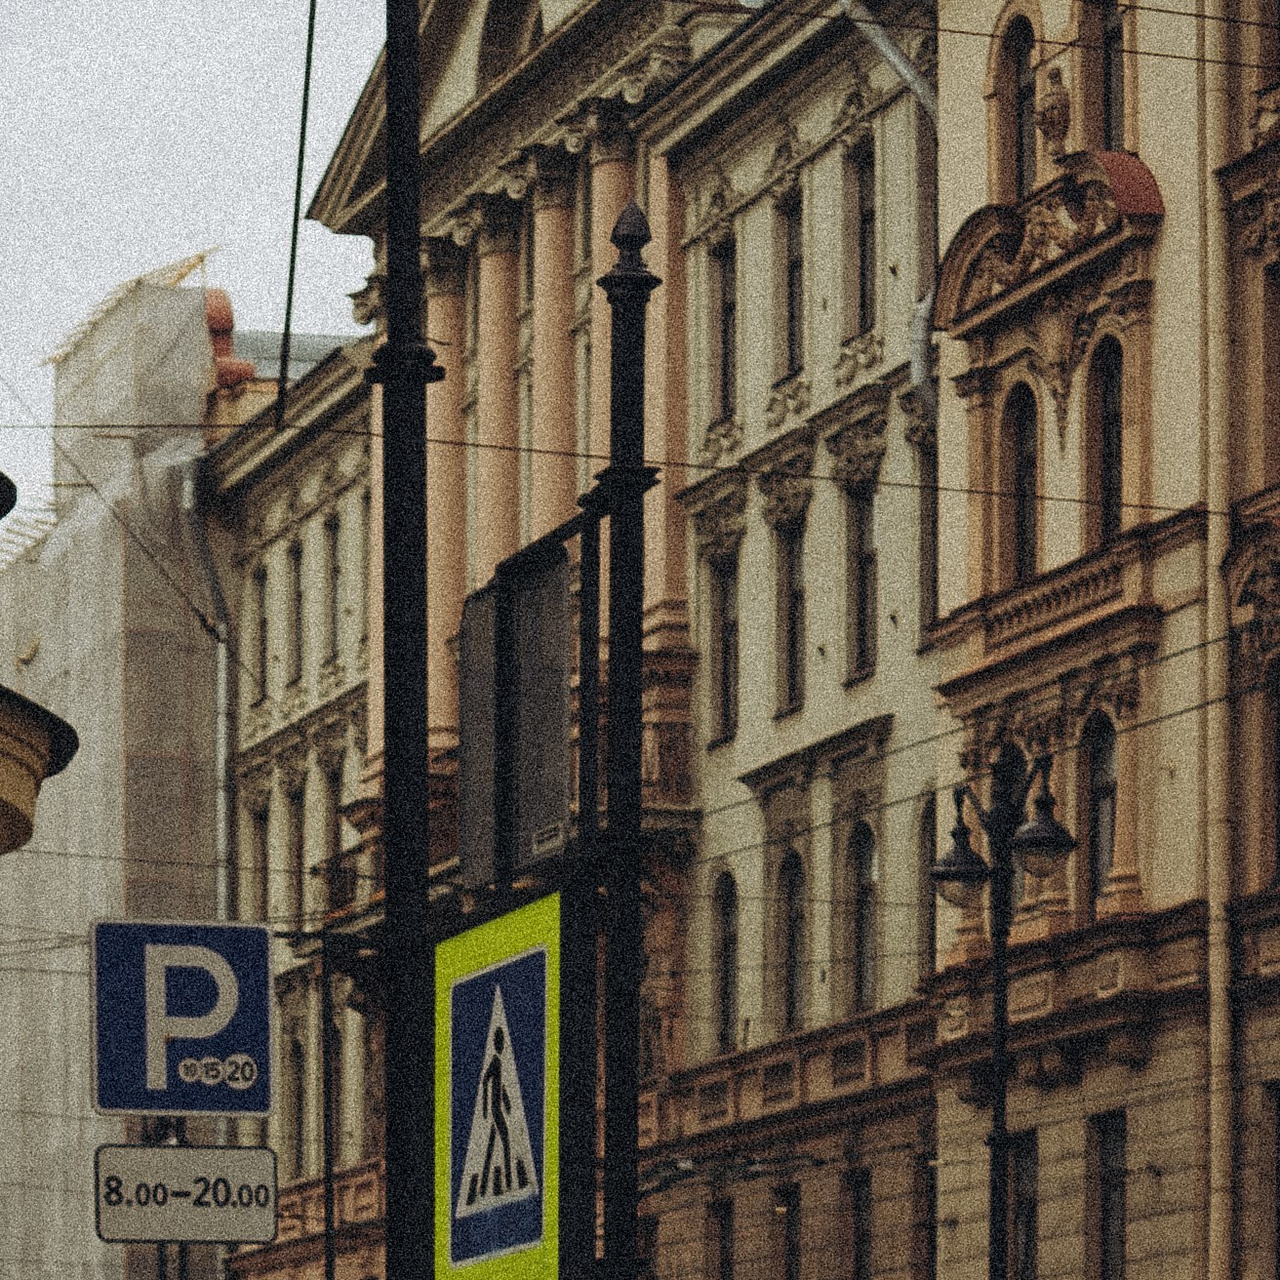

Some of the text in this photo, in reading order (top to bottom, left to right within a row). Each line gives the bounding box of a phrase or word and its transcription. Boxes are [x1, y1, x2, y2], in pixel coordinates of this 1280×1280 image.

[145, 943, 239, 1090] P
[183, 1060, 254, 1082] 10 15 20
[103, 1176, 269, 1208] 8.00-20.00
